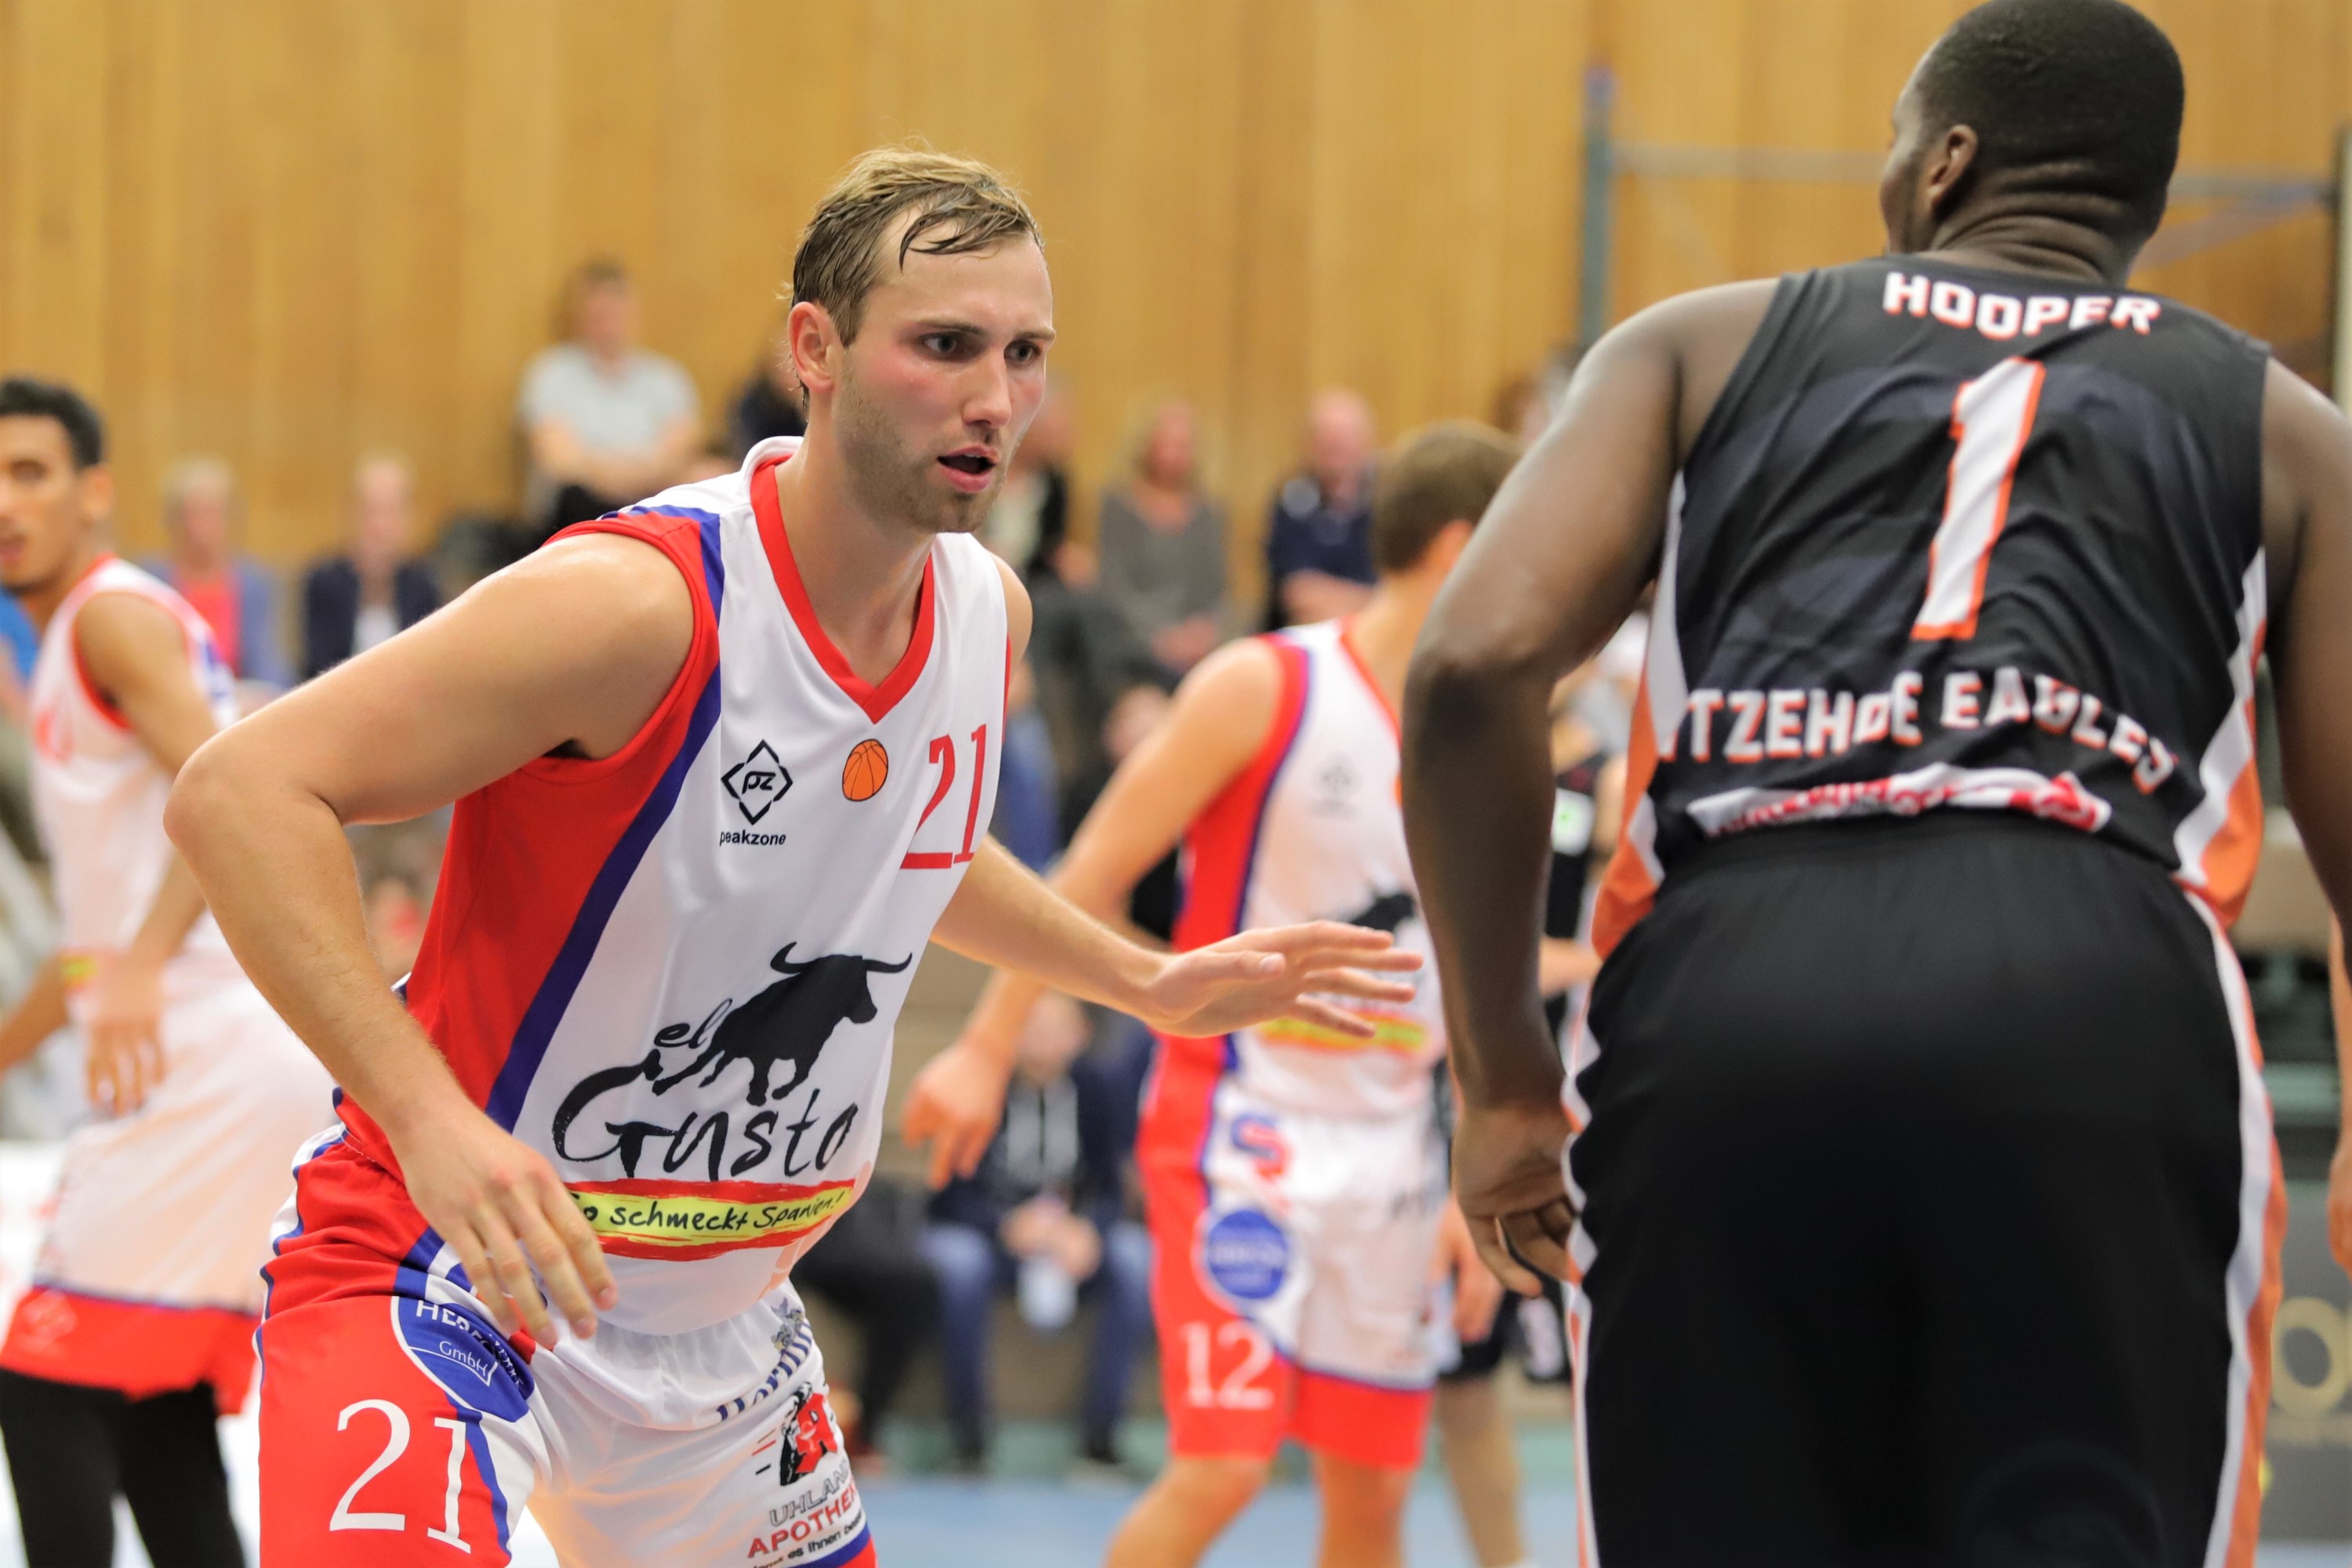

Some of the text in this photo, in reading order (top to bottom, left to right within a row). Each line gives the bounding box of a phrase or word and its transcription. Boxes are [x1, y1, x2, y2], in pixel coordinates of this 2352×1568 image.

[1882, 271, 2162, 341] HOOPER
[1911, 355, 2047, 640] 1
[899, 723, 987, 870] 21
[720, 829, 786, 847] peakzone
[654, 998, 733, 1049] el
[552, 1048, 859, 1182] Gusto
[609, 1200, 748, 1232] schmeckt
[753, 1190, 846, 1229] Spanien!
[439, 1341, 488, 1377] GmbH
[1179, 1320, 1275, 1410] 12
[329, 1398, 471, 1555] 21
[769, 1458, 849, 1527] UHLAN
